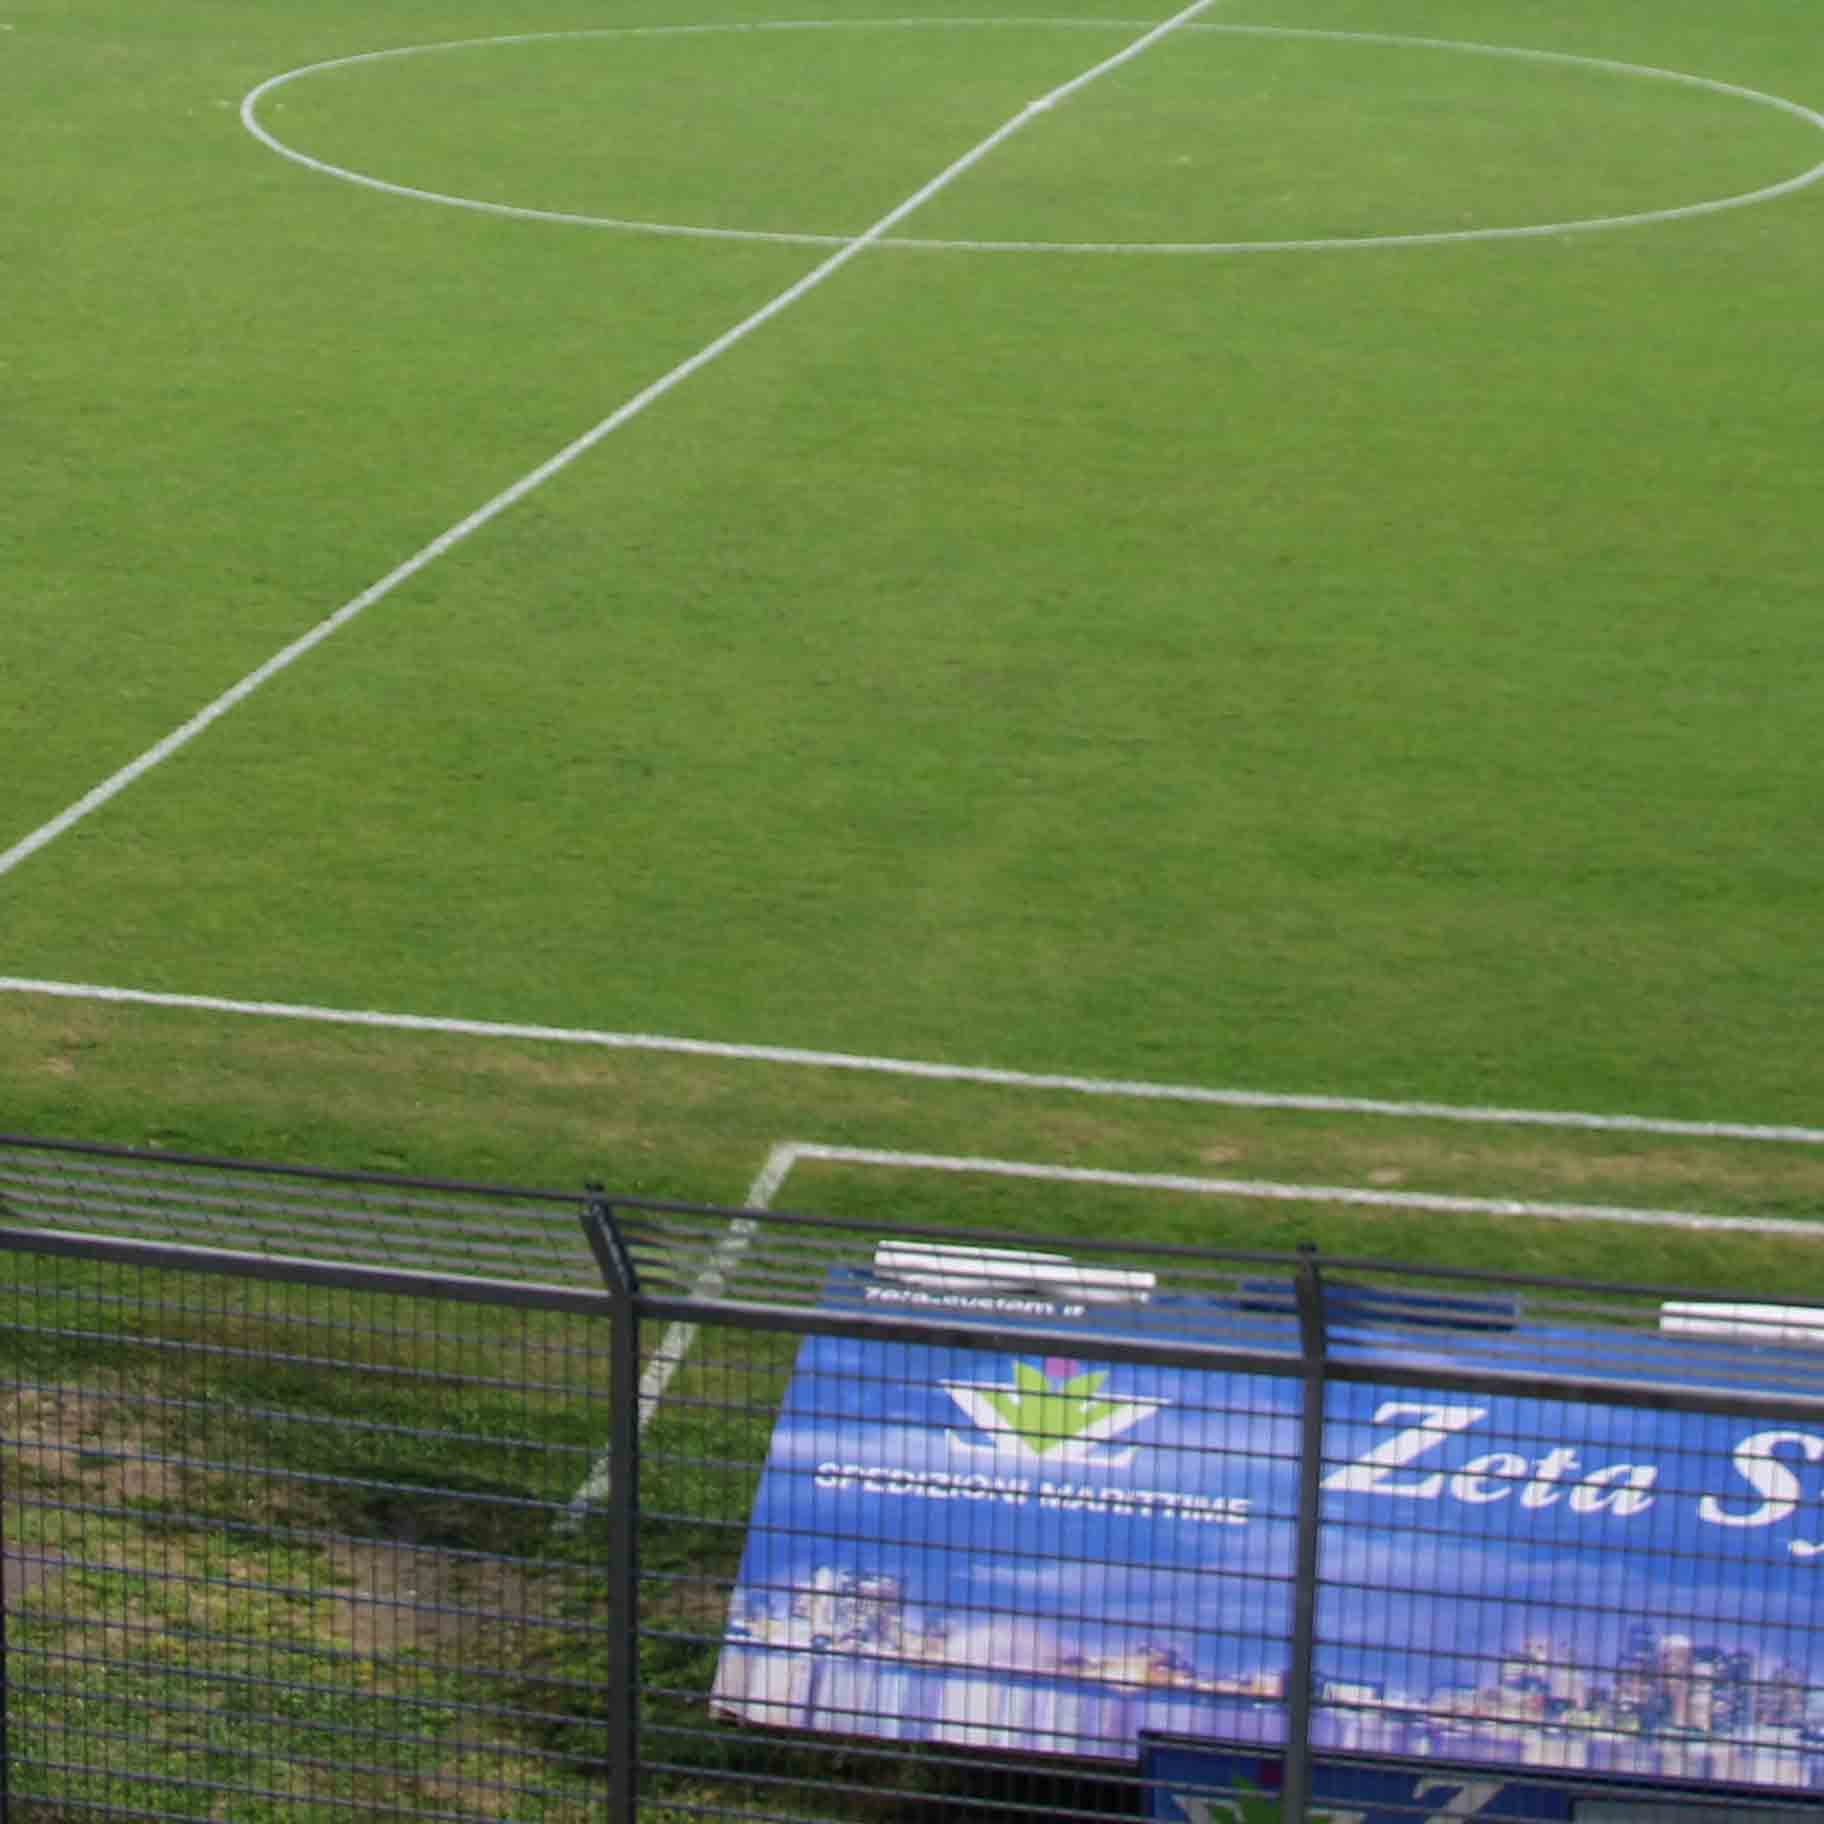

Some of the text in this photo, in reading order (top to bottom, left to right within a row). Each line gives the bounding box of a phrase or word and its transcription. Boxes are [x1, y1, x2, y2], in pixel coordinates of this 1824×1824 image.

[815, 1461, 1251, 1524] SPEDIZIONI MARITTIME
[1319, 1402, 1658, 1516] Zeta
